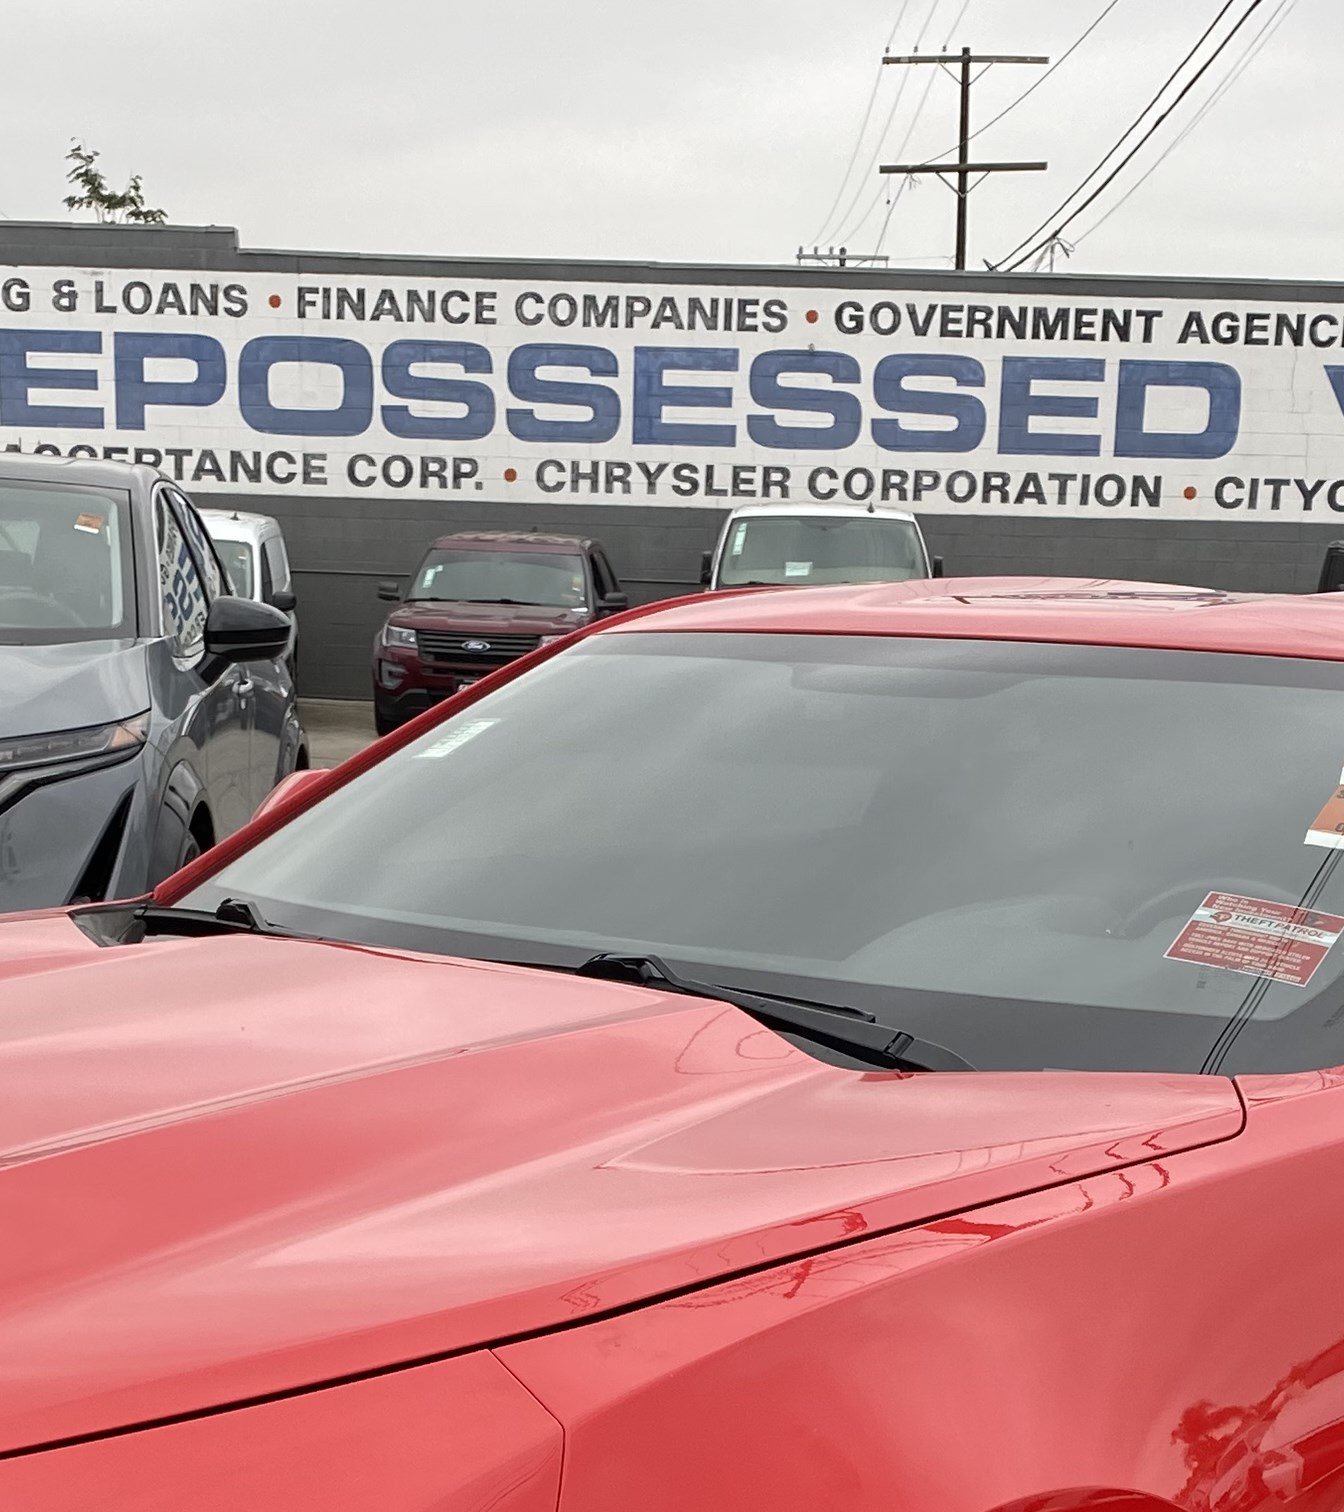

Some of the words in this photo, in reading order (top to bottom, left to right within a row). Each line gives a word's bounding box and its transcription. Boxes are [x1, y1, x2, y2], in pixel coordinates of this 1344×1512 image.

[51, 279, 78, 312] &
[96, 281, 249, 317] LOANS
[297, 286, 497, 325] FINANCE
[514, 291, 788, 333] COMPANIES
[834, 300, 1163, 344] GOVERNMENT
[7, 444, 328, 486] PTANCE
[346, 452, 484, 491] CORP.
[536, 458, 790, 499] CHRYSLER
[807, 465, 1162, 507] CORPORATION
